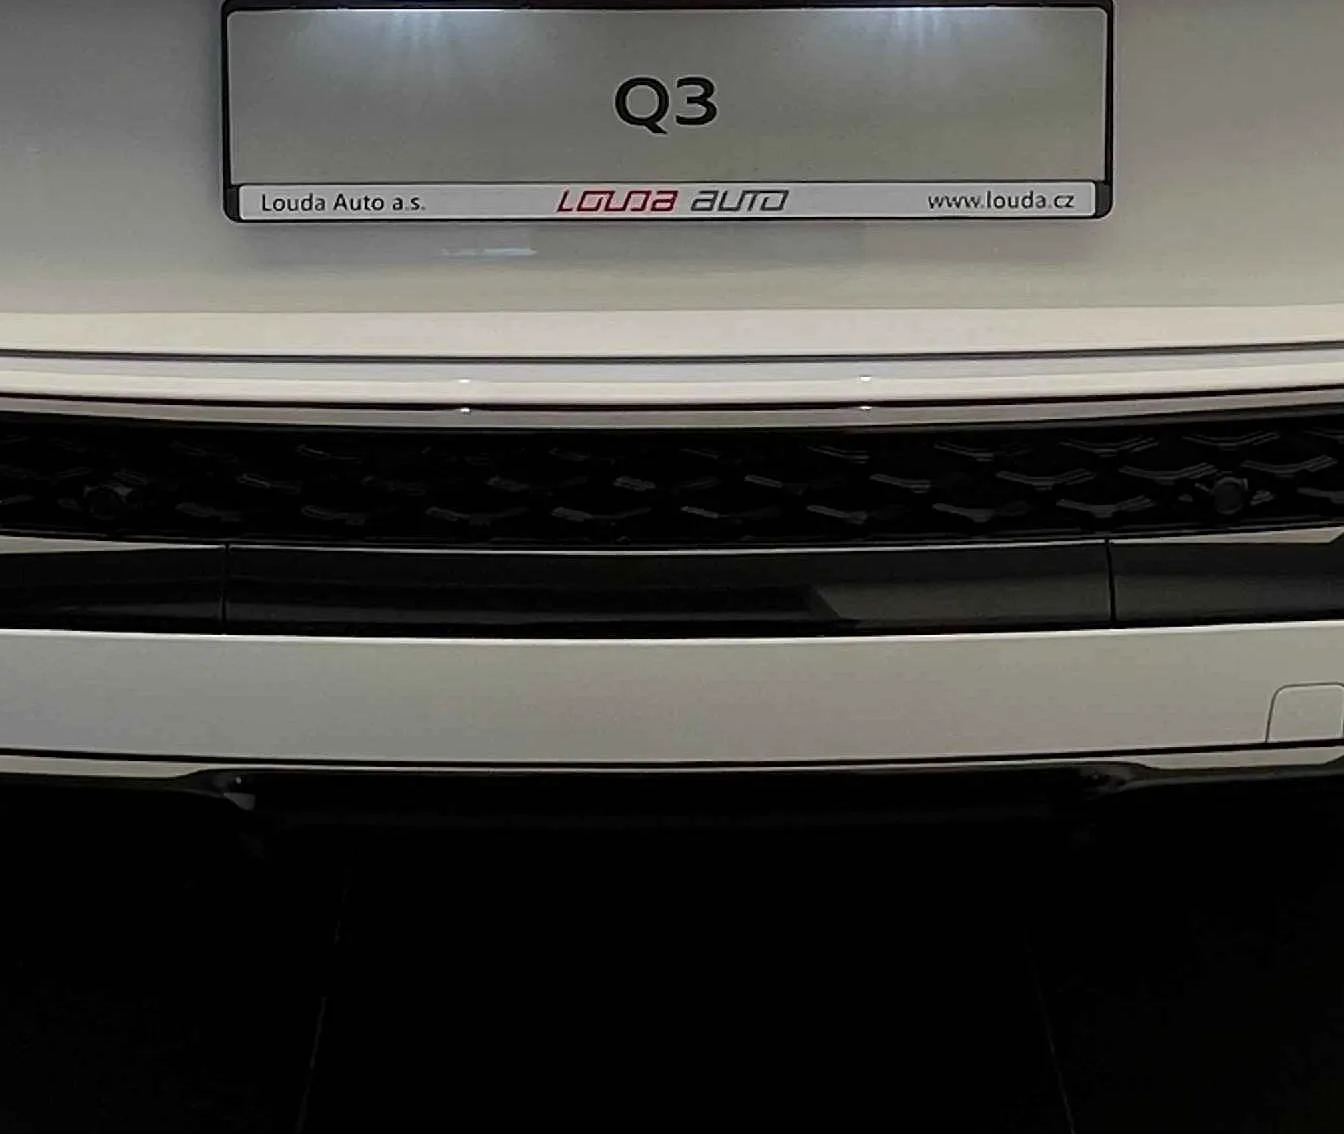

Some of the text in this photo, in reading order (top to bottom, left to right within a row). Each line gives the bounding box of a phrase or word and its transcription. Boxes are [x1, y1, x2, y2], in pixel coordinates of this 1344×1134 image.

[614, 76, 718, 135] Q3
[261, 192, 426, 212] Louda Auto a.s.
[927, 189, 1076, 210] www.louda.cz
